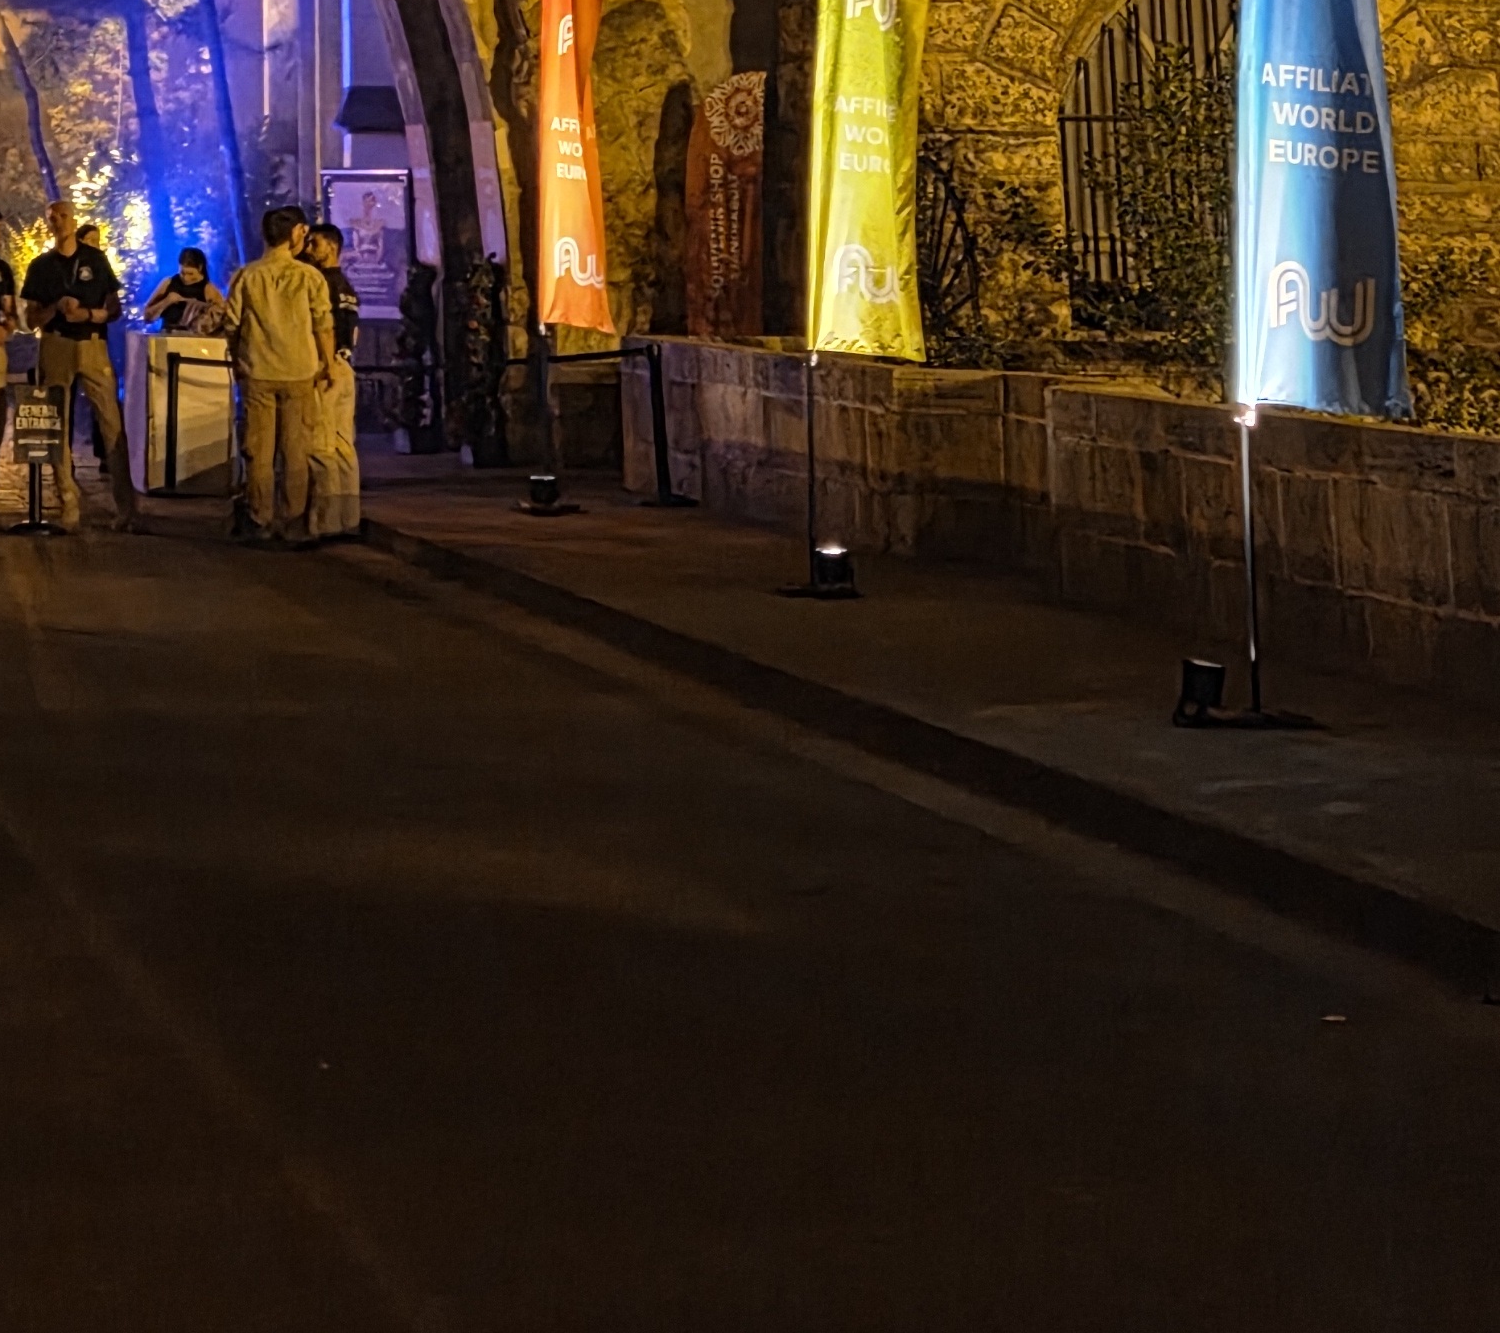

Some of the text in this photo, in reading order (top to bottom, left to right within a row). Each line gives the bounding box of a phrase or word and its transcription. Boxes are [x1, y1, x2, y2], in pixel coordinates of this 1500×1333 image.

[1272, 101, 1376, 134] WORLD
[1269, 138, 1380, 175] EUROPE
[709, 153, 724, 203] SHOP
